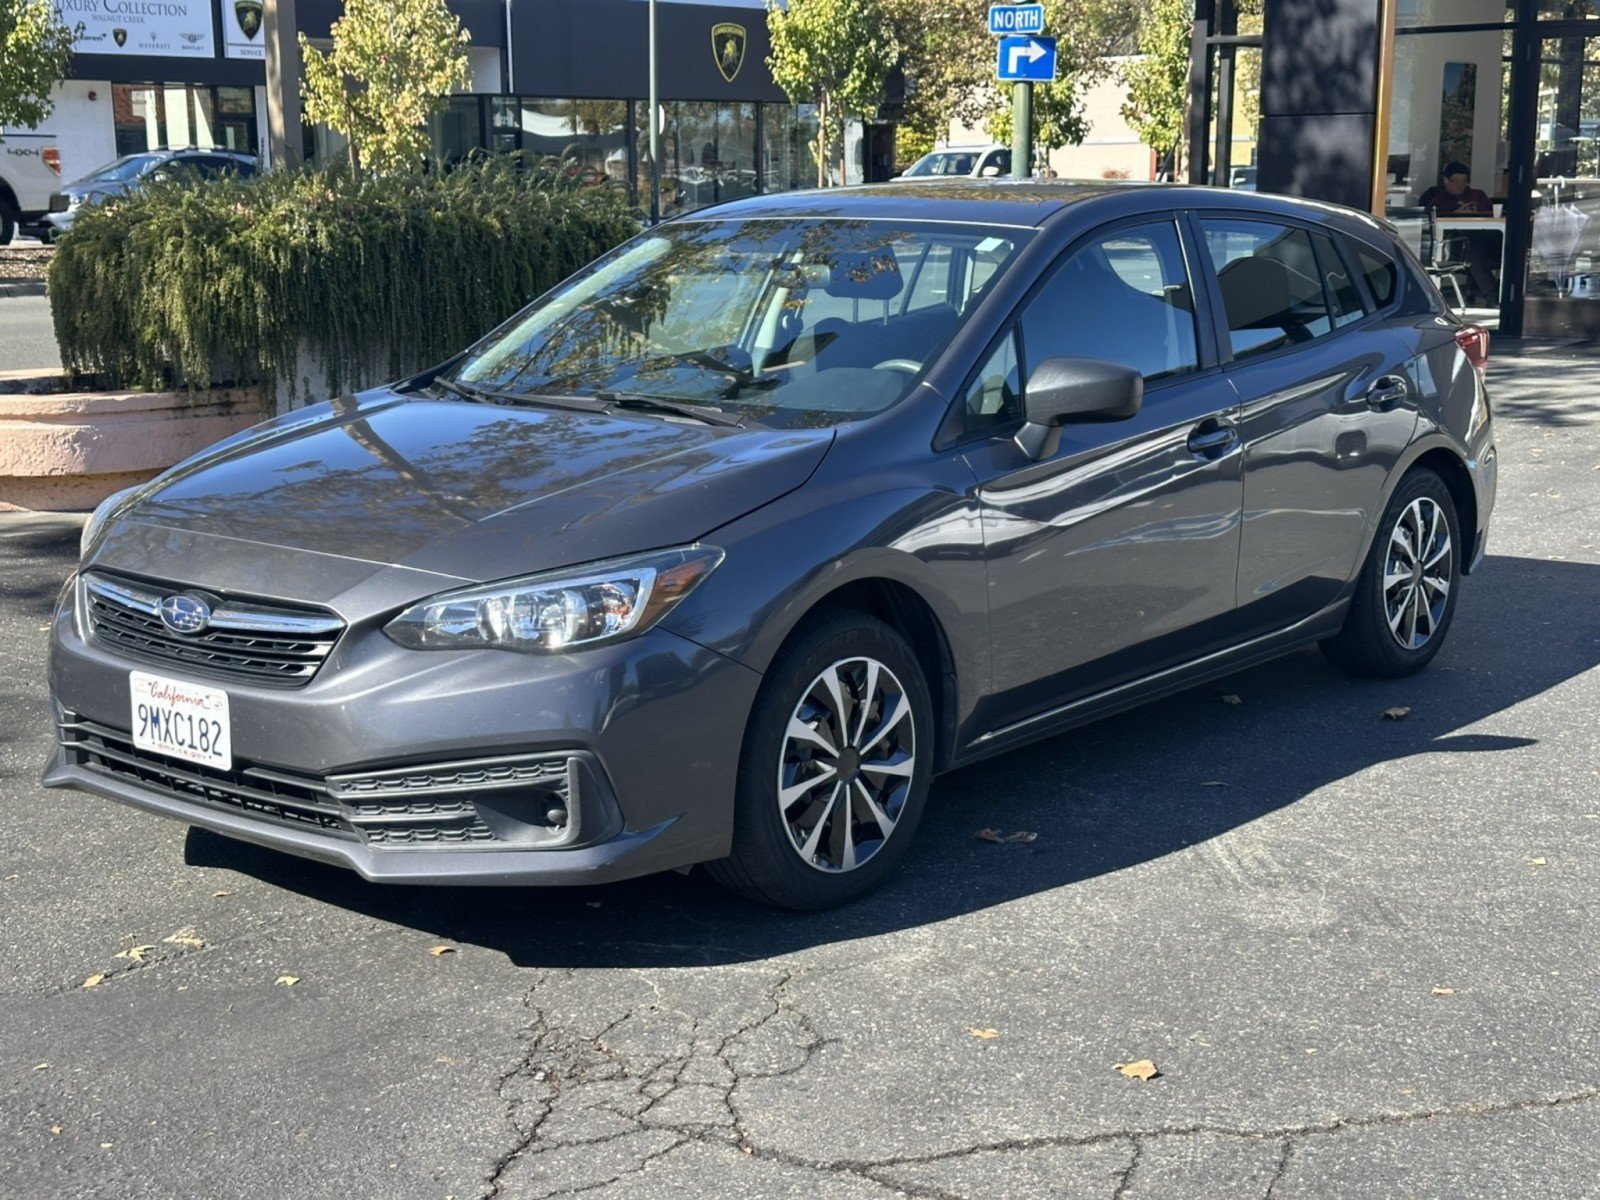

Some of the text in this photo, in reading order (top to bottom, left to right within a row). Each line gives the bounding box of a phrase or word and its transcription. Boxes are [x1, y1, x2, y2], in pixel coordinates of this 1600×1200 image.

[103, 0, 187, 17] COLLECTION
[91, 14, 146, 24] WALNUT CREEK
[993, 9, 1039, 28] NORTH
[240, 49, 263, 57] SERVICE
[150, 680, 211, 710] California
[138, 703, 223, 758] 9MXC182
